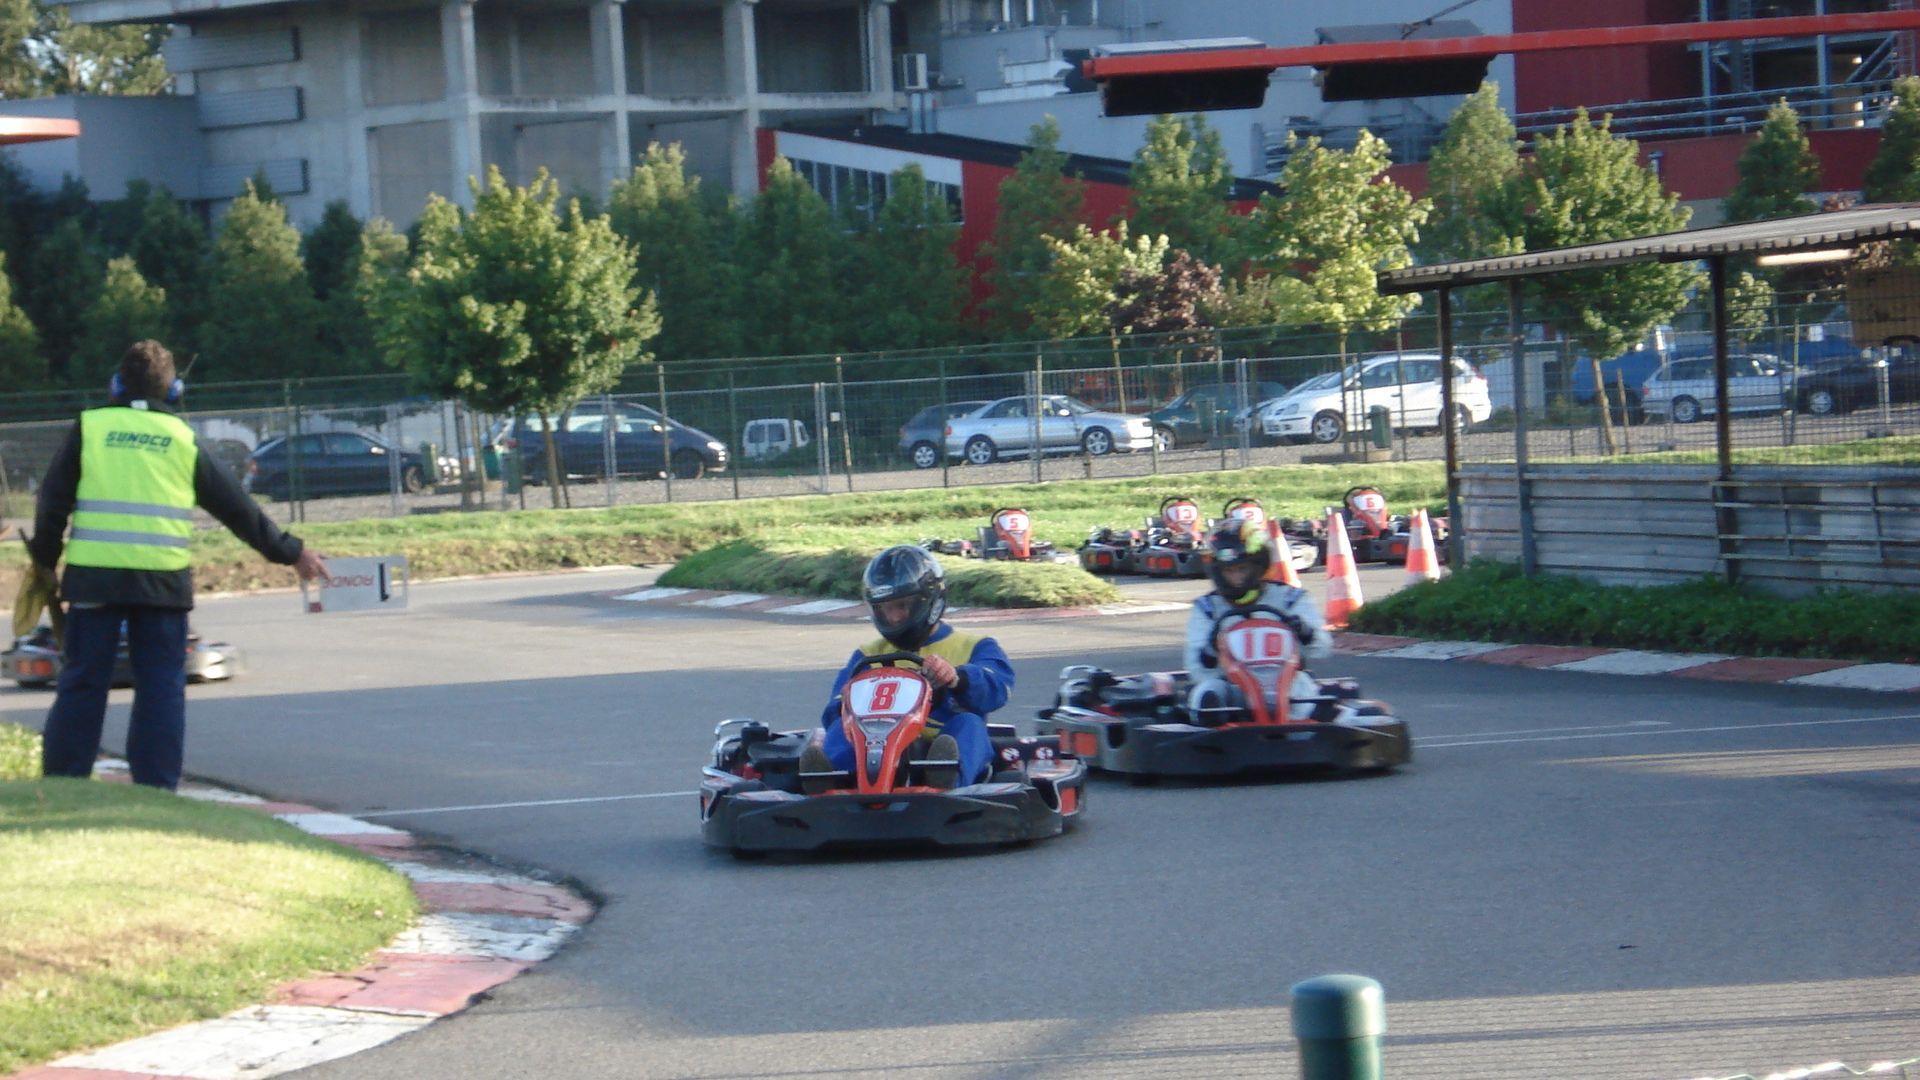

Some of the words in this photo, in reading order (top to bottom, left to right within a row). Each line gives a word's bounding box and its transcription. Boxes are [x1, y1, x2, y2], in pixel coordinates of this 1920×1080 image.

[1009, 517, 1019, 529] 5
[378, 562, 390, 602] 1
[1243, 631, 1284, 659] 10
[868, 681, 901, 713] 8
